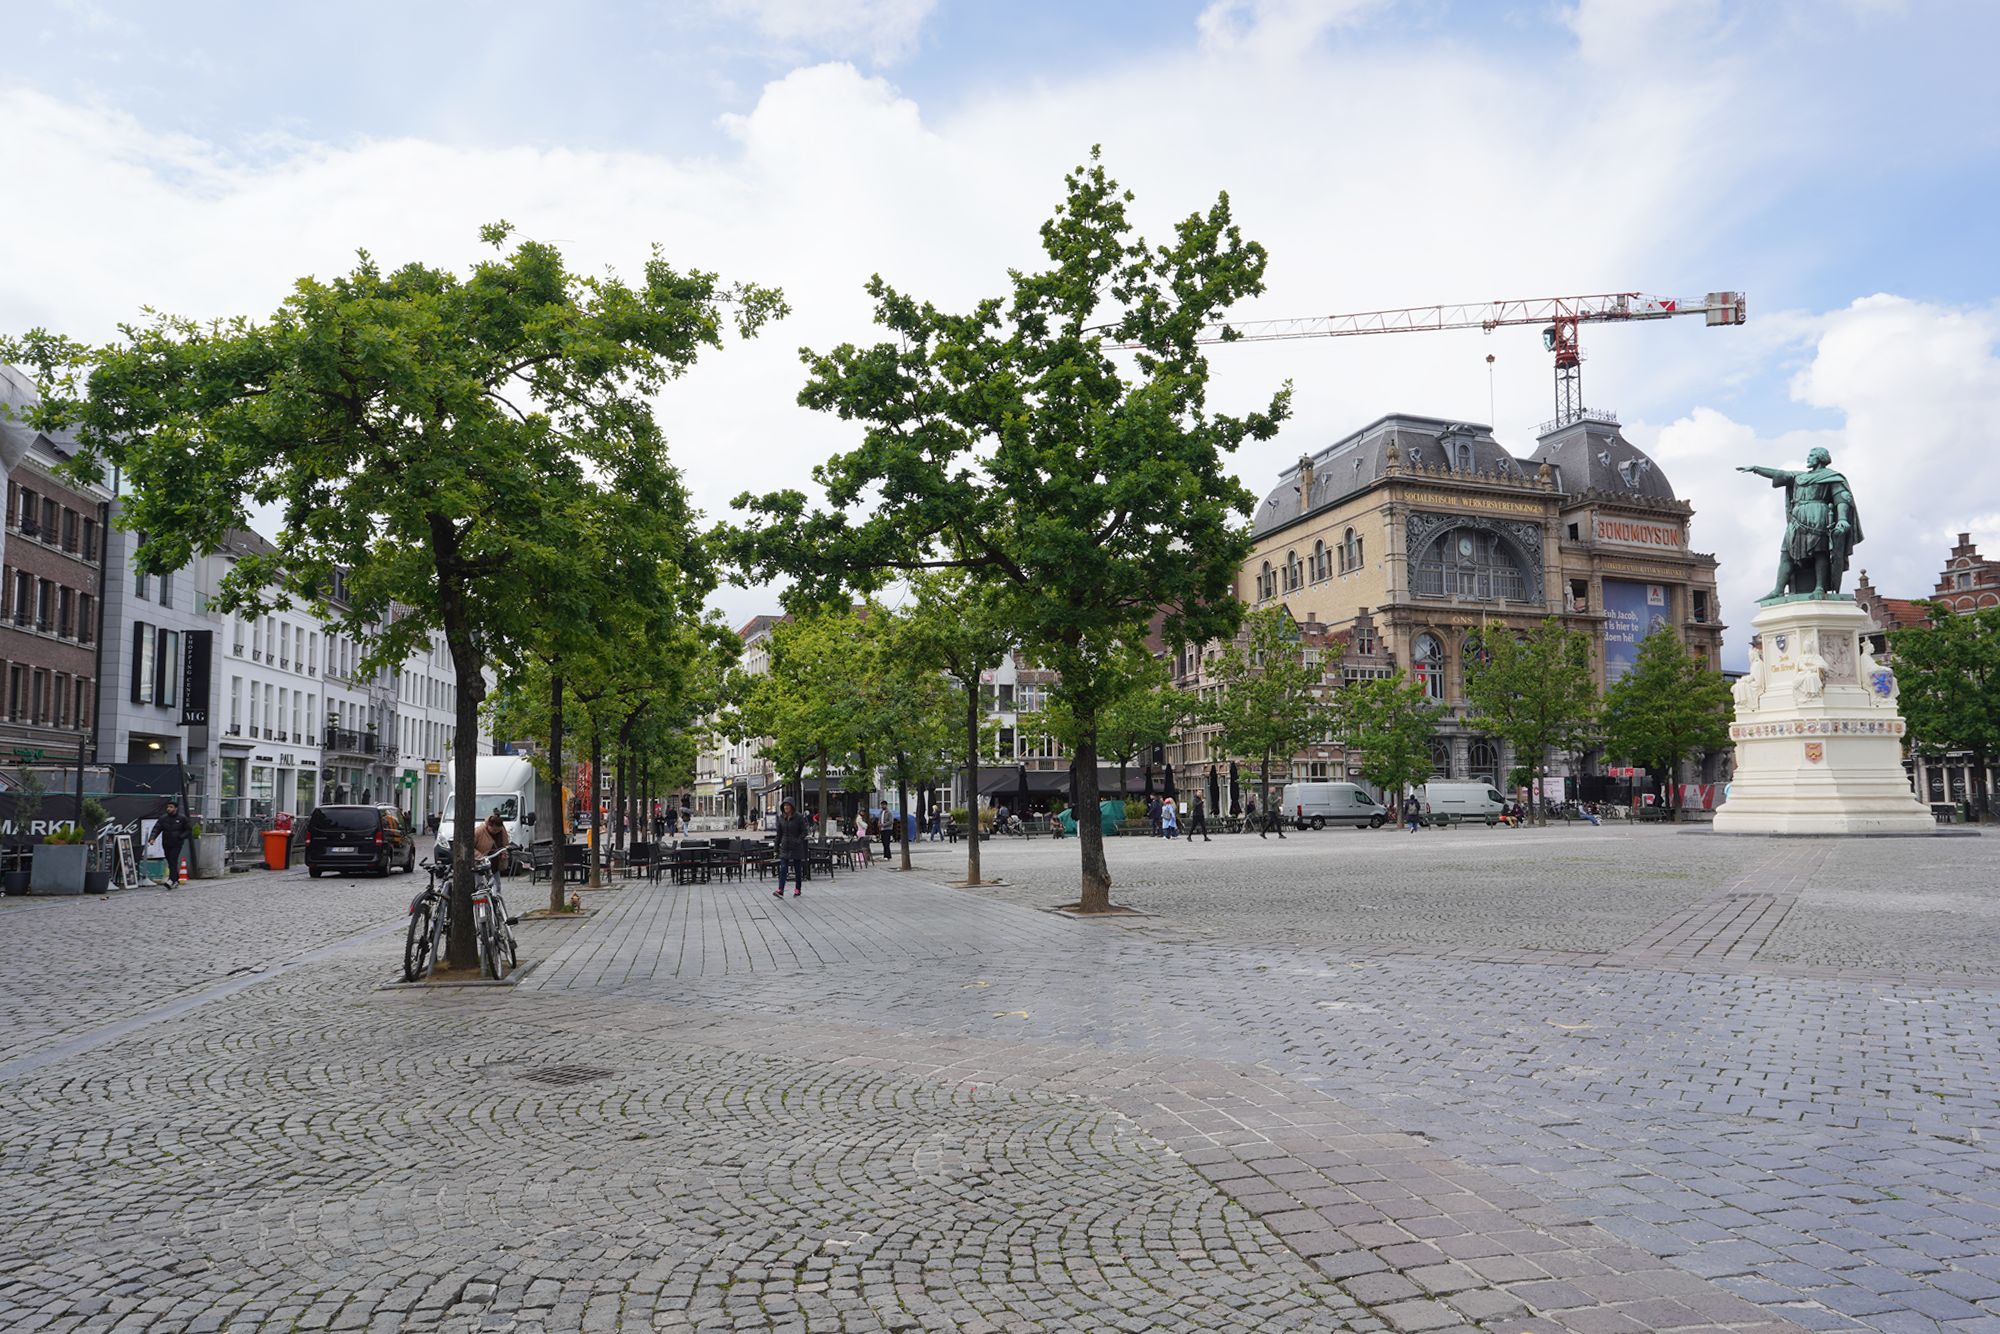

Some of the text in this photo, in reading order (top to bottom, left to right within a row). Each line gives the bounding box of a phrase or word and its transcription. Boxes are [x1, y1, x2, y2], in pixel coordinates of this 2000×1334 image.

[1404, 492, 1456, 505] SOCIALISTISCHE
[1453, 616, 1473, 624] ONS
[1603, 609, 1639, 622] Euh Jacob,
[1609, 621, 1615, 630] is
[1616, 621, 1630, 631] hier
[1631, 622, 1639, 632] te
[1604, 632, 1622, 642] doen
